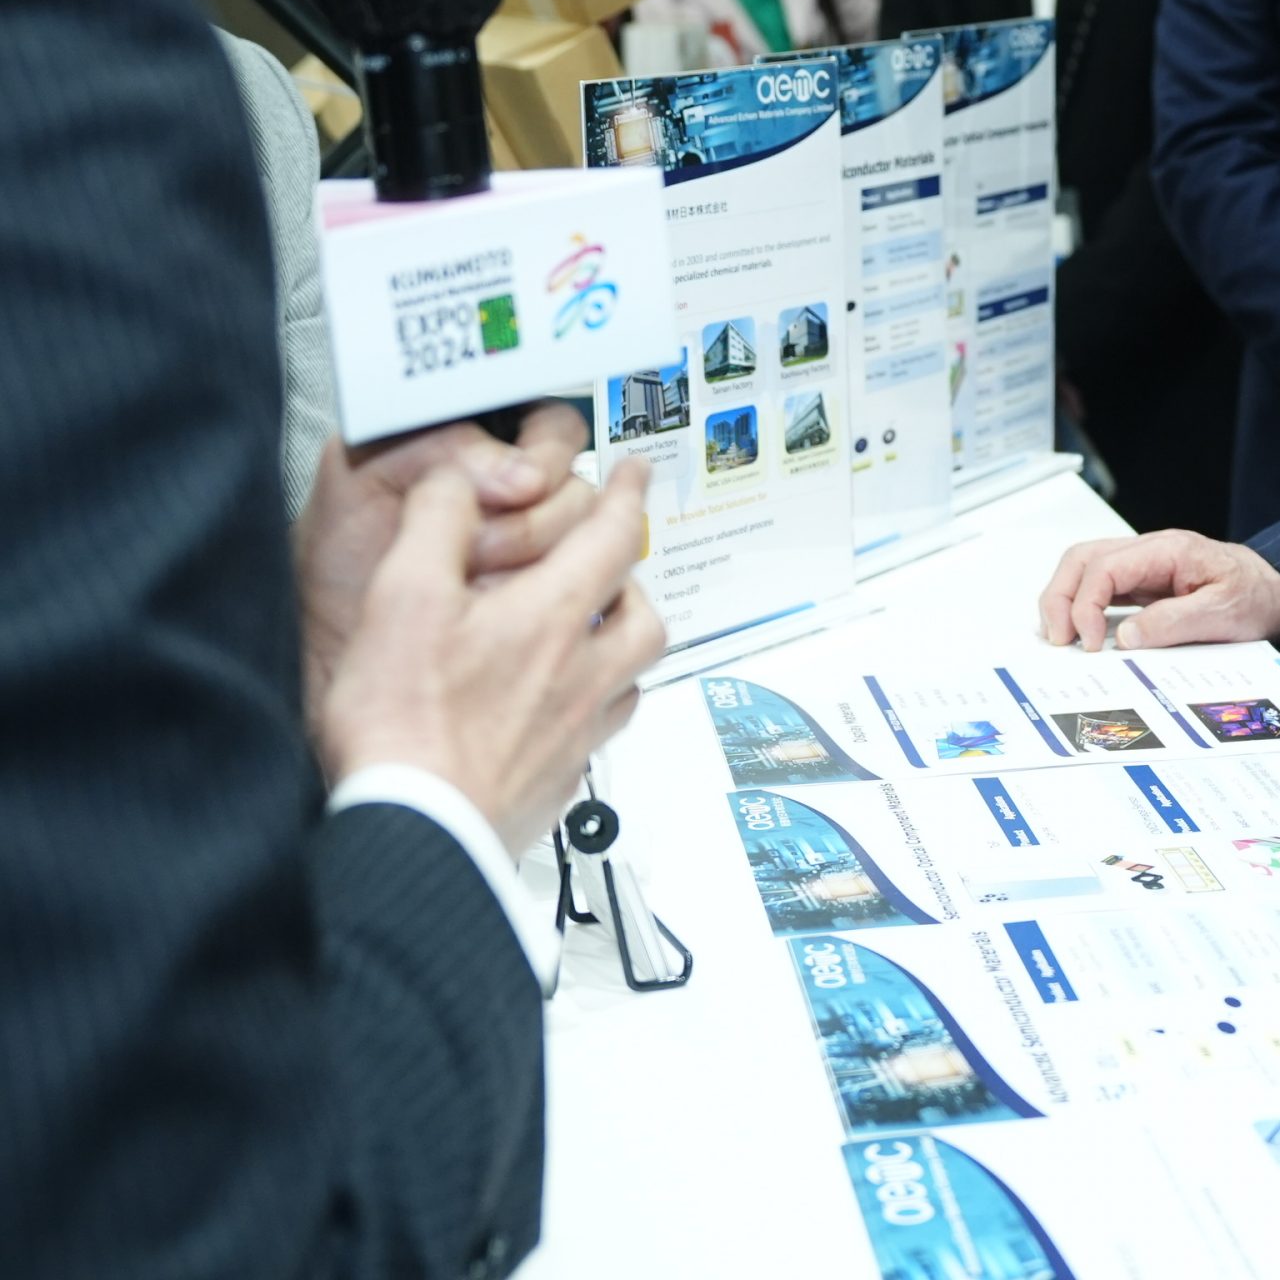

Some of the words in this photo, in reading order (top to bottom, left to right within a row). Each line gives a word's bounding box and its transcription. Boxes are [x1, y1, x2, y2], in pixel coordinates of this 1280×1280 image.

[662, 534, 714, 557] Semiconductor
[715, 524, 749, 542] advanced
[749, 518, 775, 535] process
[663, 566, 686, 581] CMOS
[687, 558, 709, 574] image
[663, 583, 701, 603] Micro-LED
